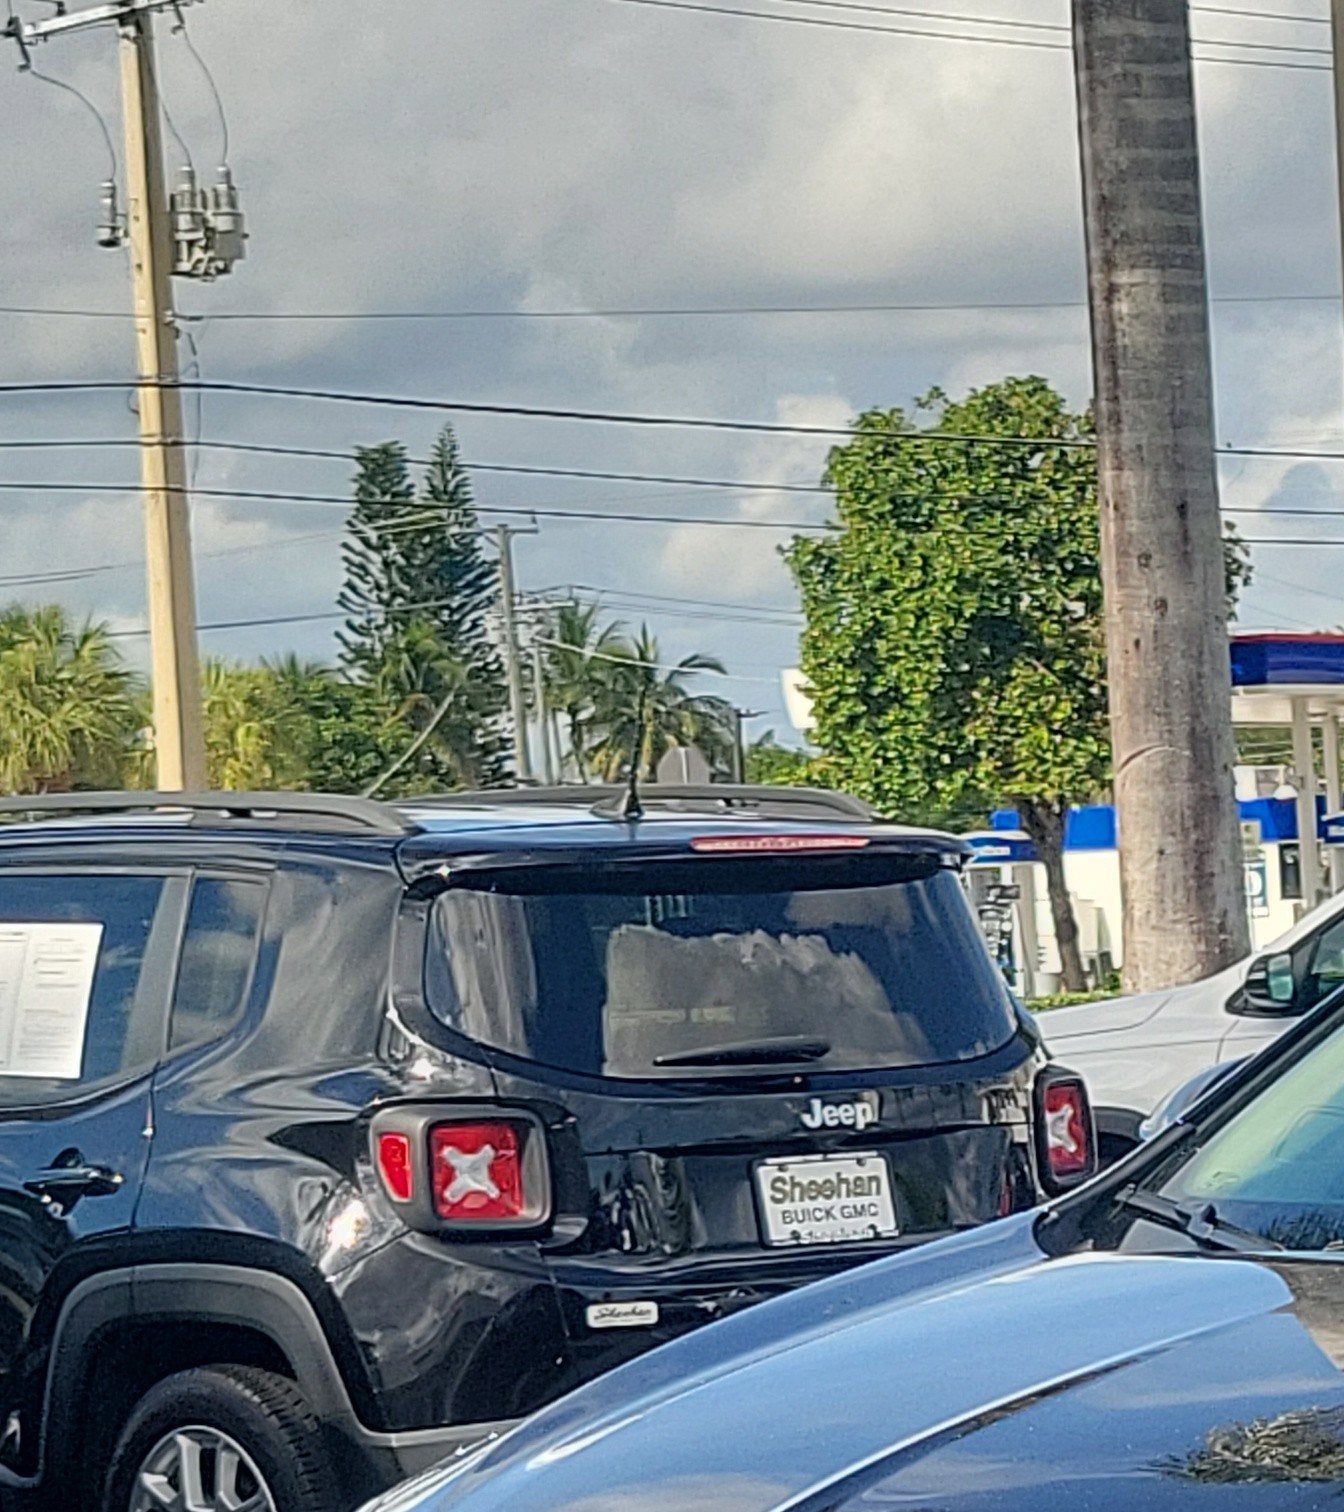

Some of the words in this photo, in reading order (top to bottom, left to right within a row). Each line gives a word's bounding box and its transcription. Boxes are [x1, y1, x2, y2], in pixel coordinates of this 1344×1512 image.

[801, 1098, 874, 1130] Jeep
[769, 1171, 881, 1205] Sheehan
[782, 1205, 838, 1225] BUICK
[840, 1202, 880, 1219] GMC
